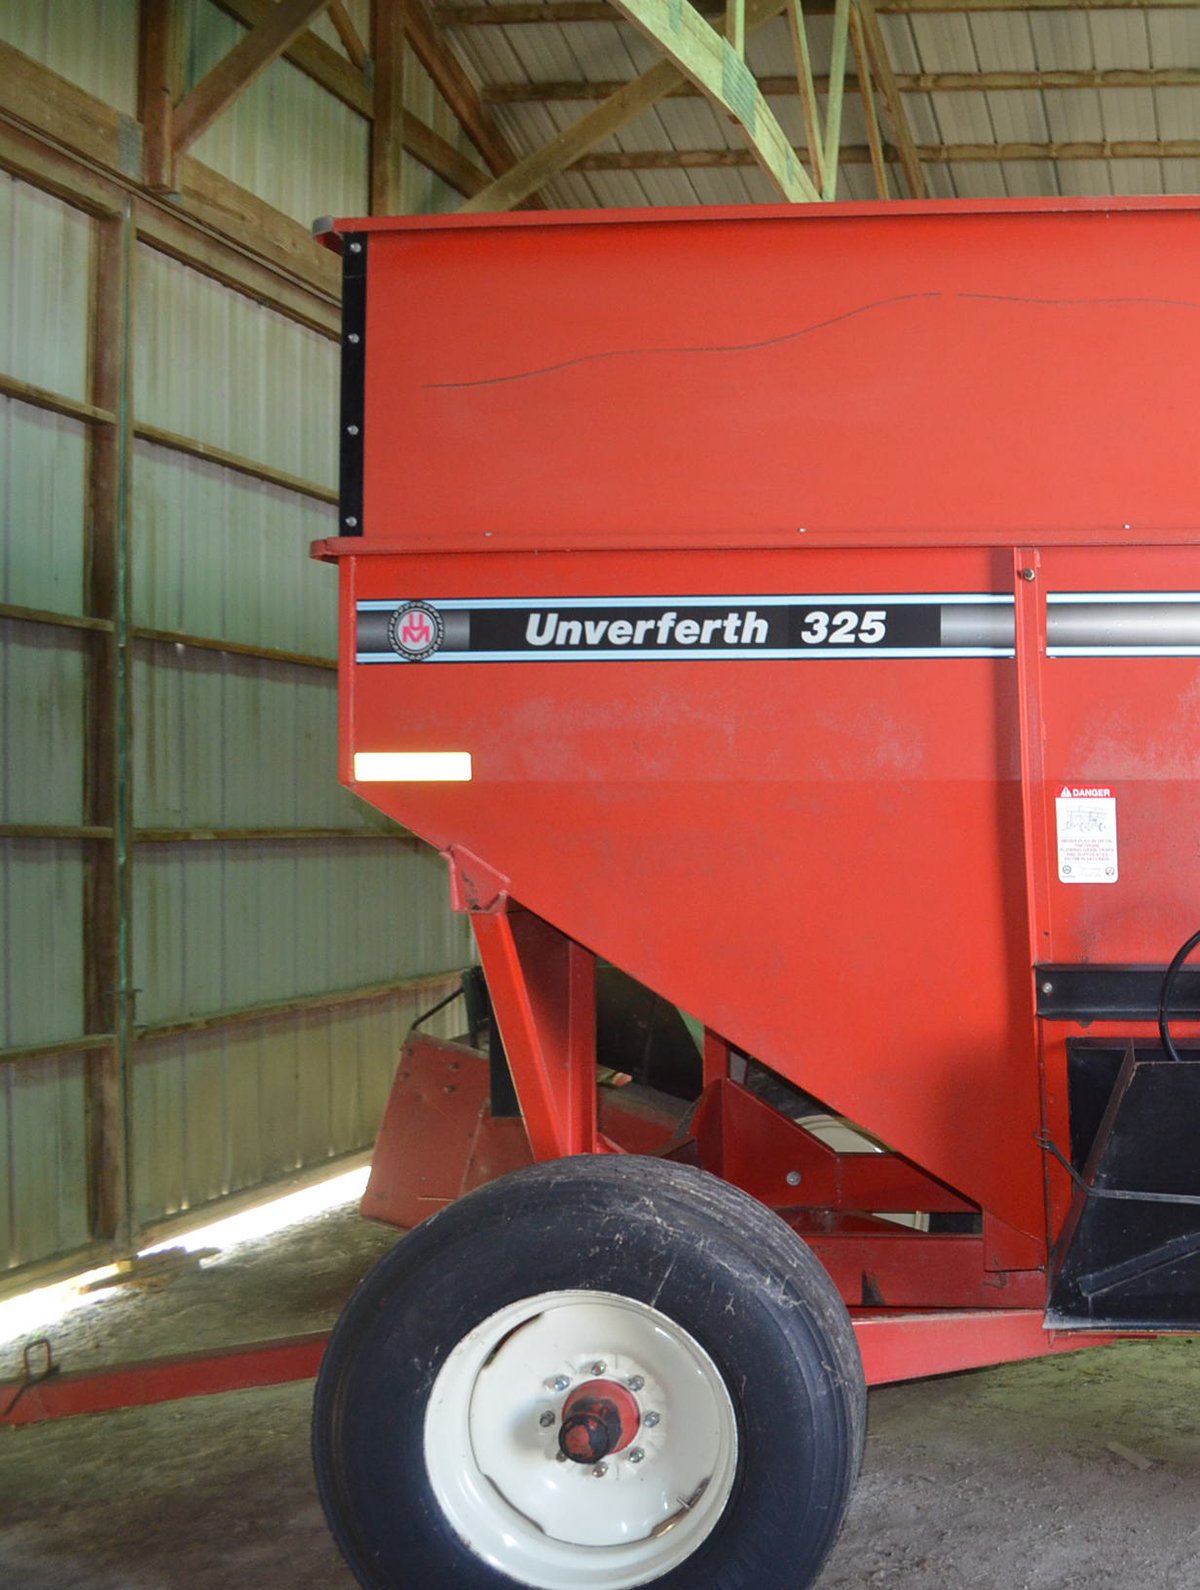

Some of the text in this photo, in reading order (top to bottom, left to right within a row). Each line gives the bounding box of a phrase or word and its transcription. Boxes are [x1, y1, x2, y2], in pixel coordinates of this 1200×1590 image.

[525, 610, 887, 646] Unverferth 325
[1072, 788, 1111, 797] DANGER
